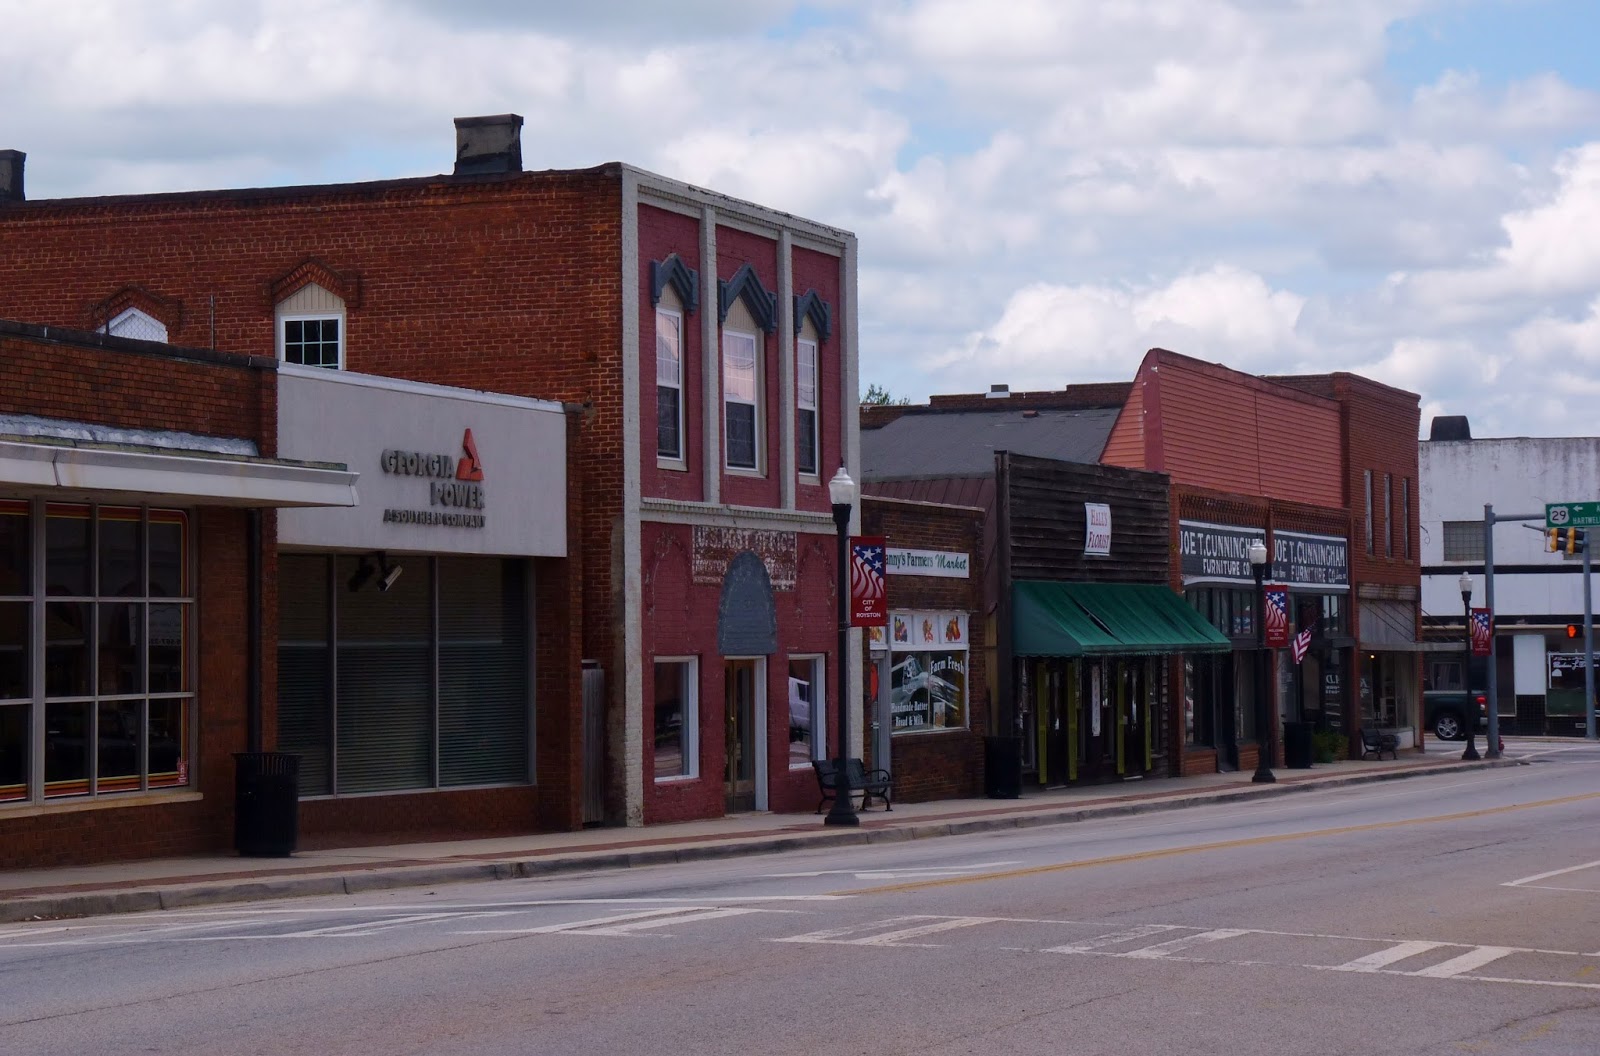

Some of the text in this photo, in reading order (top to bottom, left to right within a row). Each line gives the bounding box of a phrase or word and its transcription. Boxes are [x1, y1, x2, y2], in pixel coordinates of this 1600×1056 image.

[381, 449, 455, 478] GEORGIA
[430, 481, 486, 509] POWER
[383, 509, 486, 528] A SOUTHERN COMPANY
[1552, 510, 1566, 521] 29
[1572, 516, 1600, 525] HARTWEL
[721, 528, 750, 550] POST
[756, 530, 795, 552] OFFICE
[1087, 531, 1110, 549] FLORIST
[1180, 530, 1196, 555] JOE
[1273, 539, 1287, 562] JOE
[907, 552, 933, 568] Farmers
[935, 554, 967, 570] Market
[1203, 558, 1240, 576] FURNITURE
[1291, 564, 1326, 583] FURNITURE
[930, 656, 964, 675] Farm Fresh
